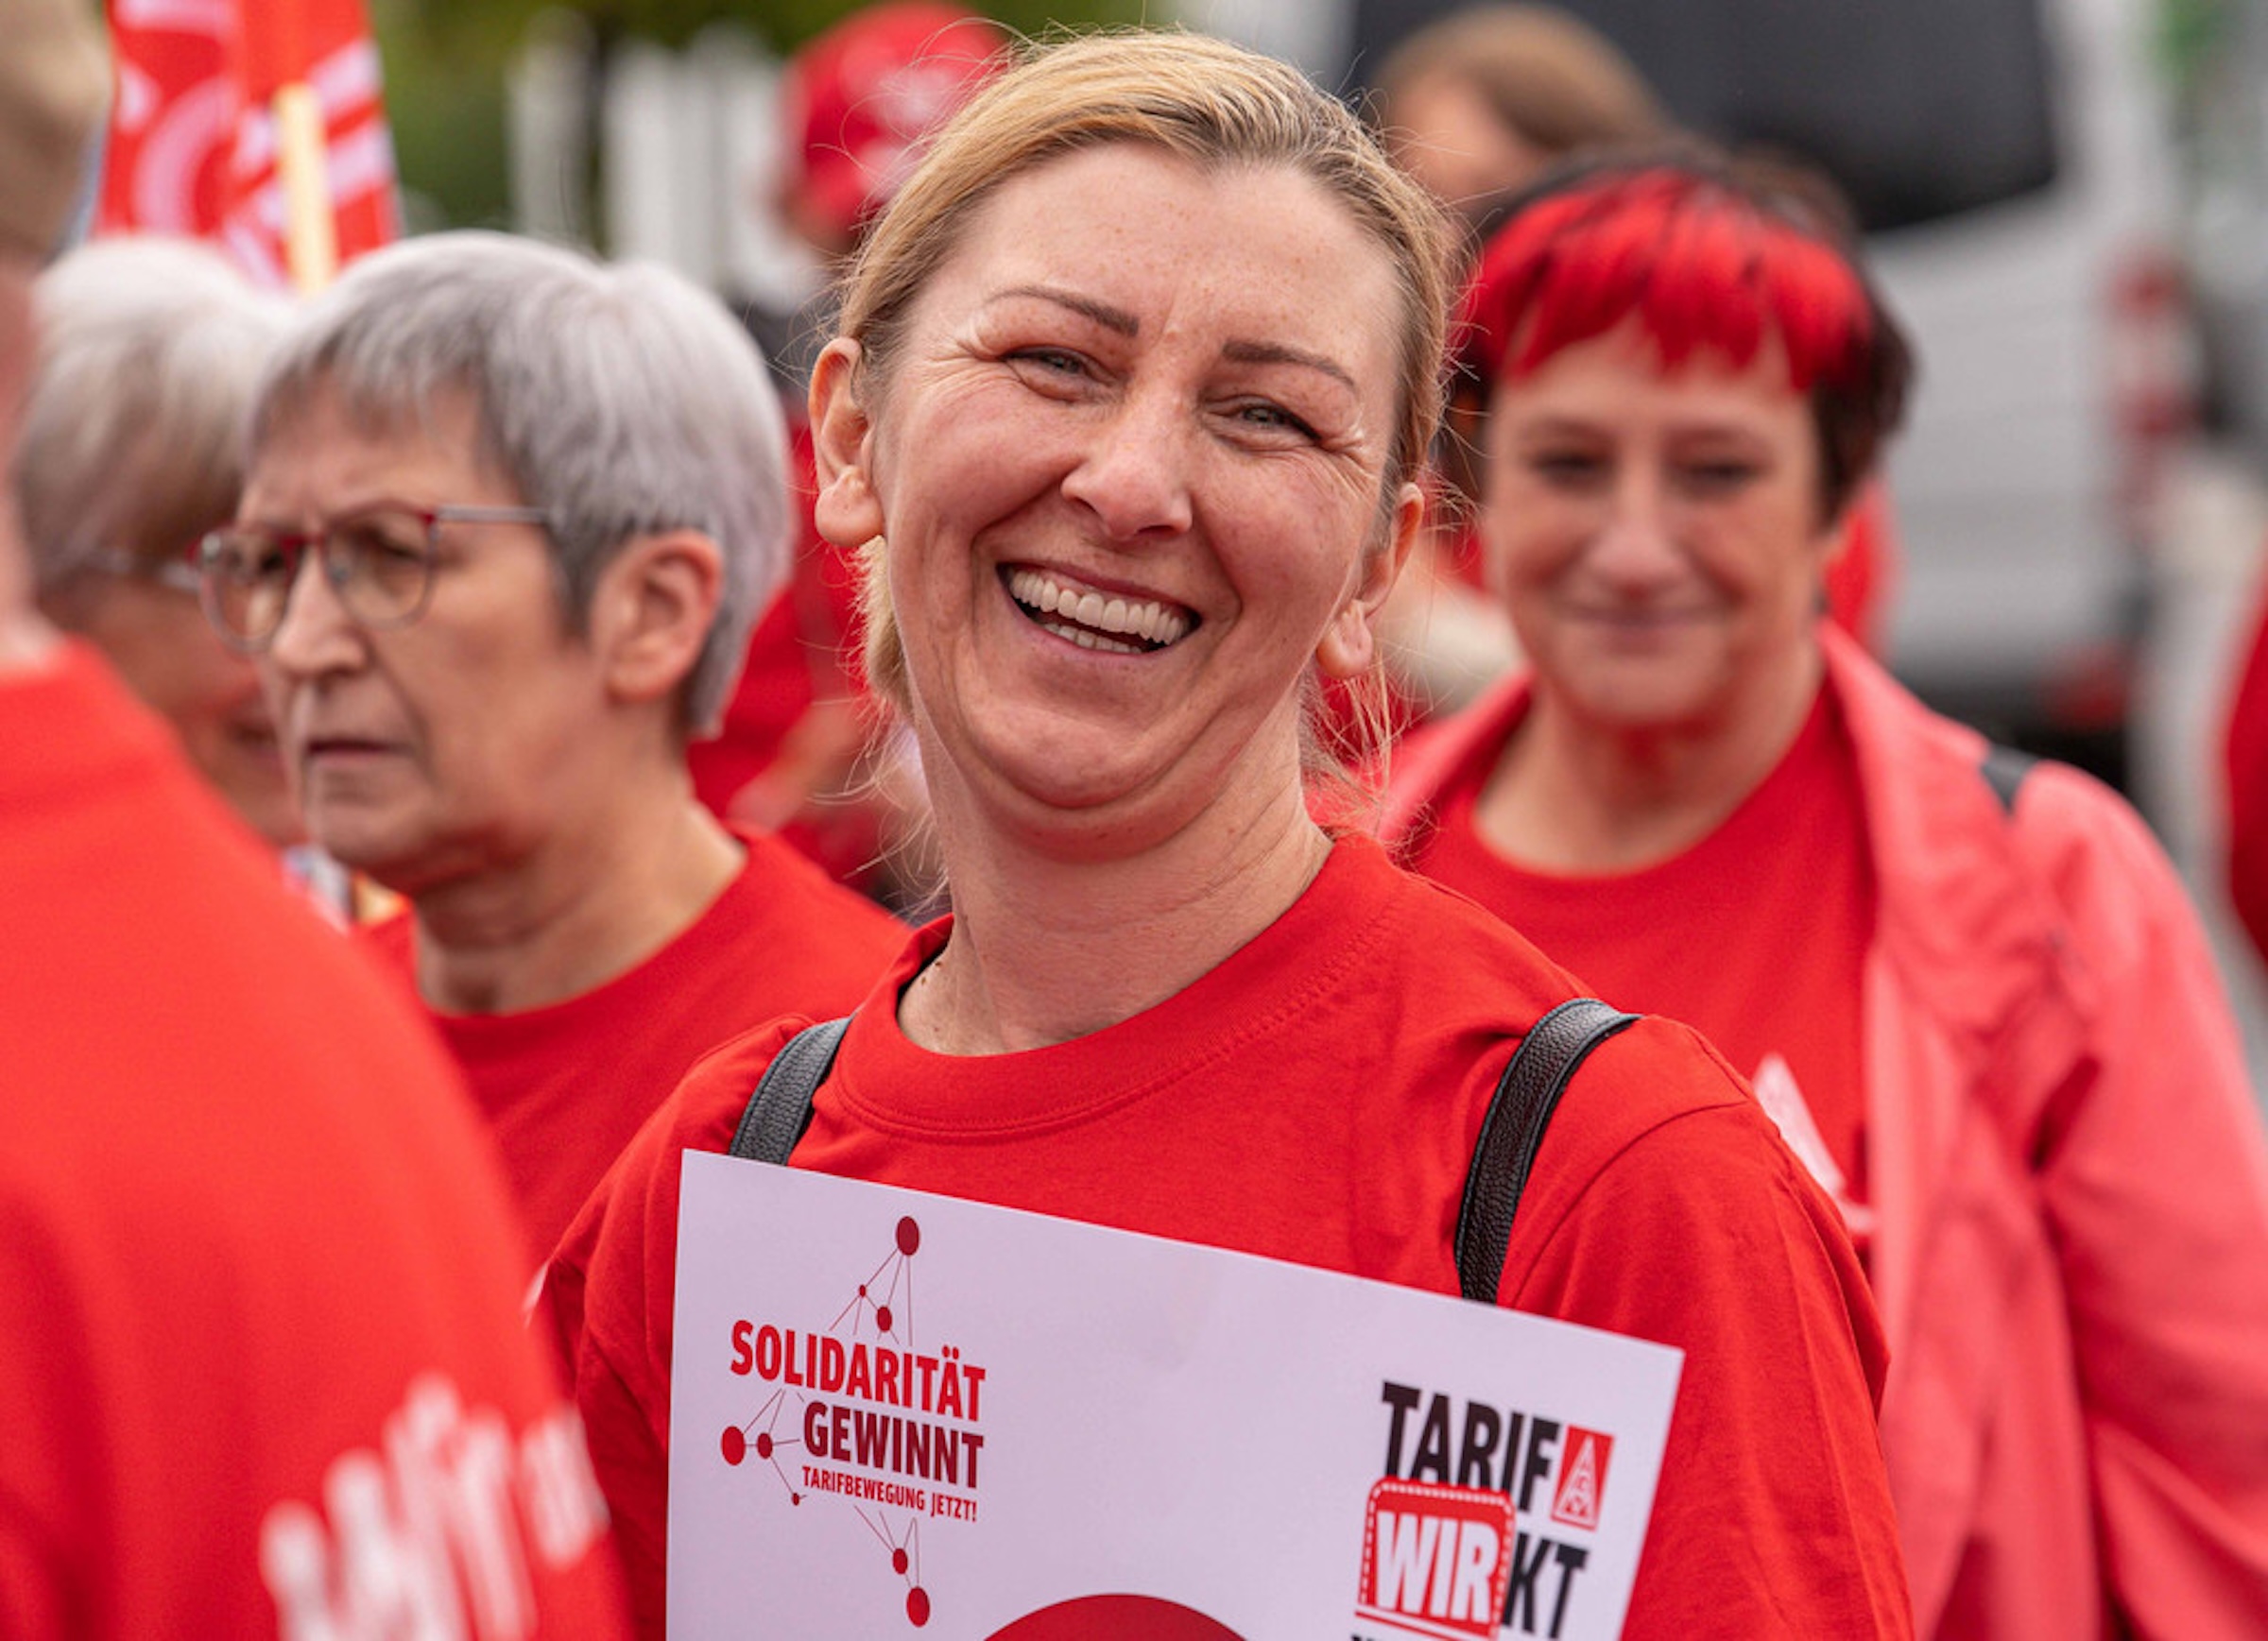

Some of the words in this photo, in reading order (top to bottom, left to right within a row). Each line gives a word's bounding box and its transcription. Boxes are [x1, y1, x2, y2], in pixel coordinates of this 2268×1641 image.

[730, 1320, 986, 1422] SOLIDARITÄT
[803, 1400, 985, 1489] GEWINNT
[1382, 1380, 1560, 1513] TARIF
[801, 1465, 926, 1512] TARIFBEWEGUNG
[930, 1492, 977, 1524] JETZT!
